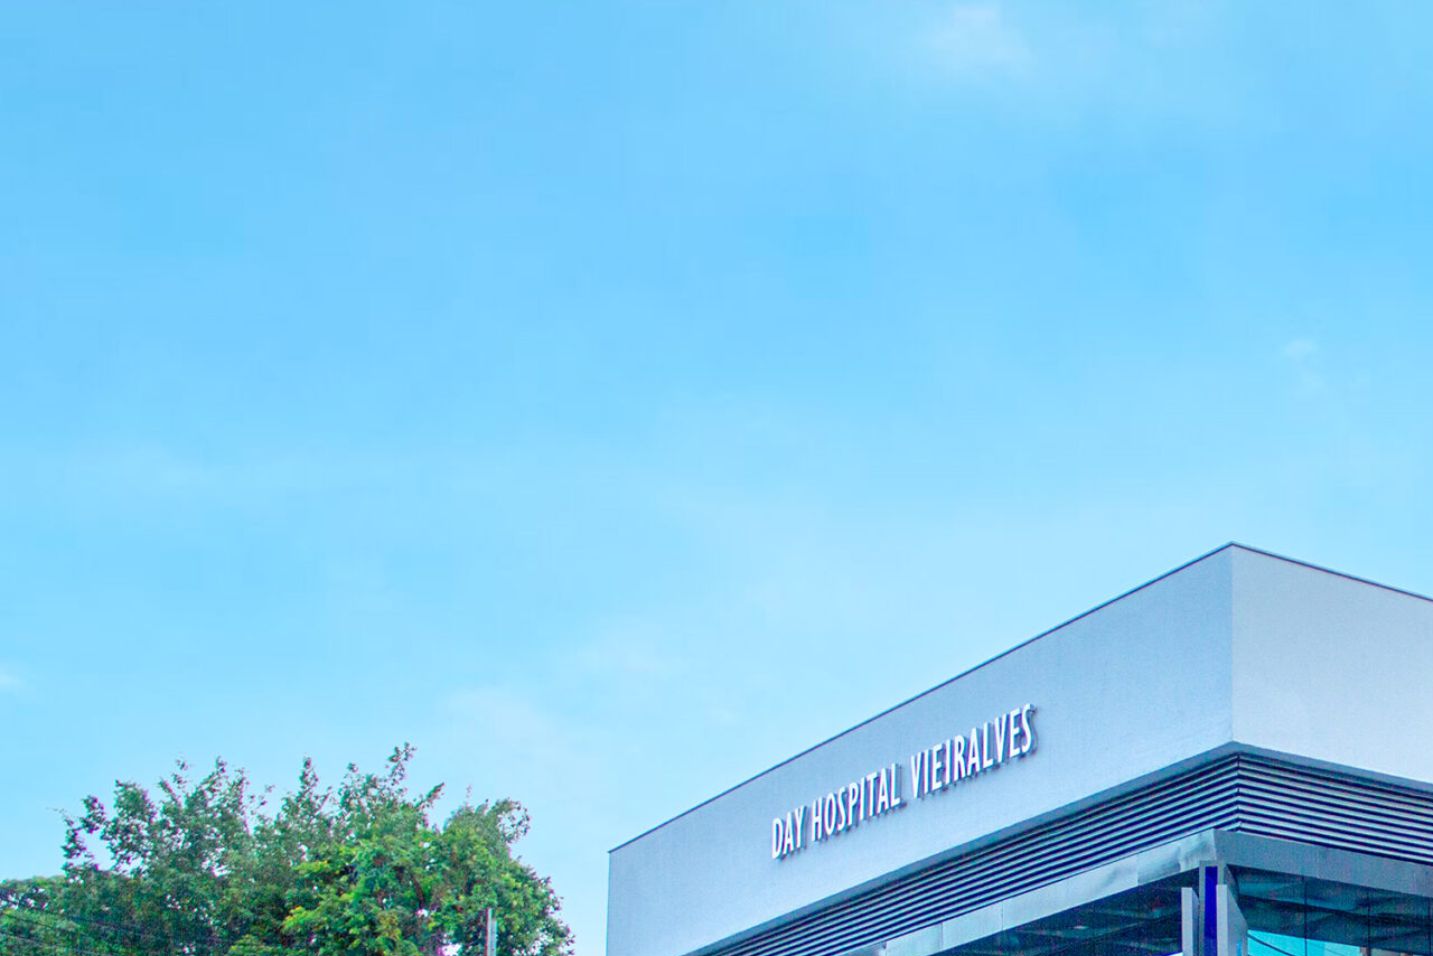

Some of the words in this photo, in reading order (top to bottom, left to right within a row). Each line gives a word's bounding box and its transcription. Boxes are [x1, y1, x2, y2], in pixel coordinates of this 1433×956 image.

[771, 805, 807, 859] DAY
[811, 763, 903, 842] HOSPITAL
[910, 703, 1036, 799] VIEIRALVES
